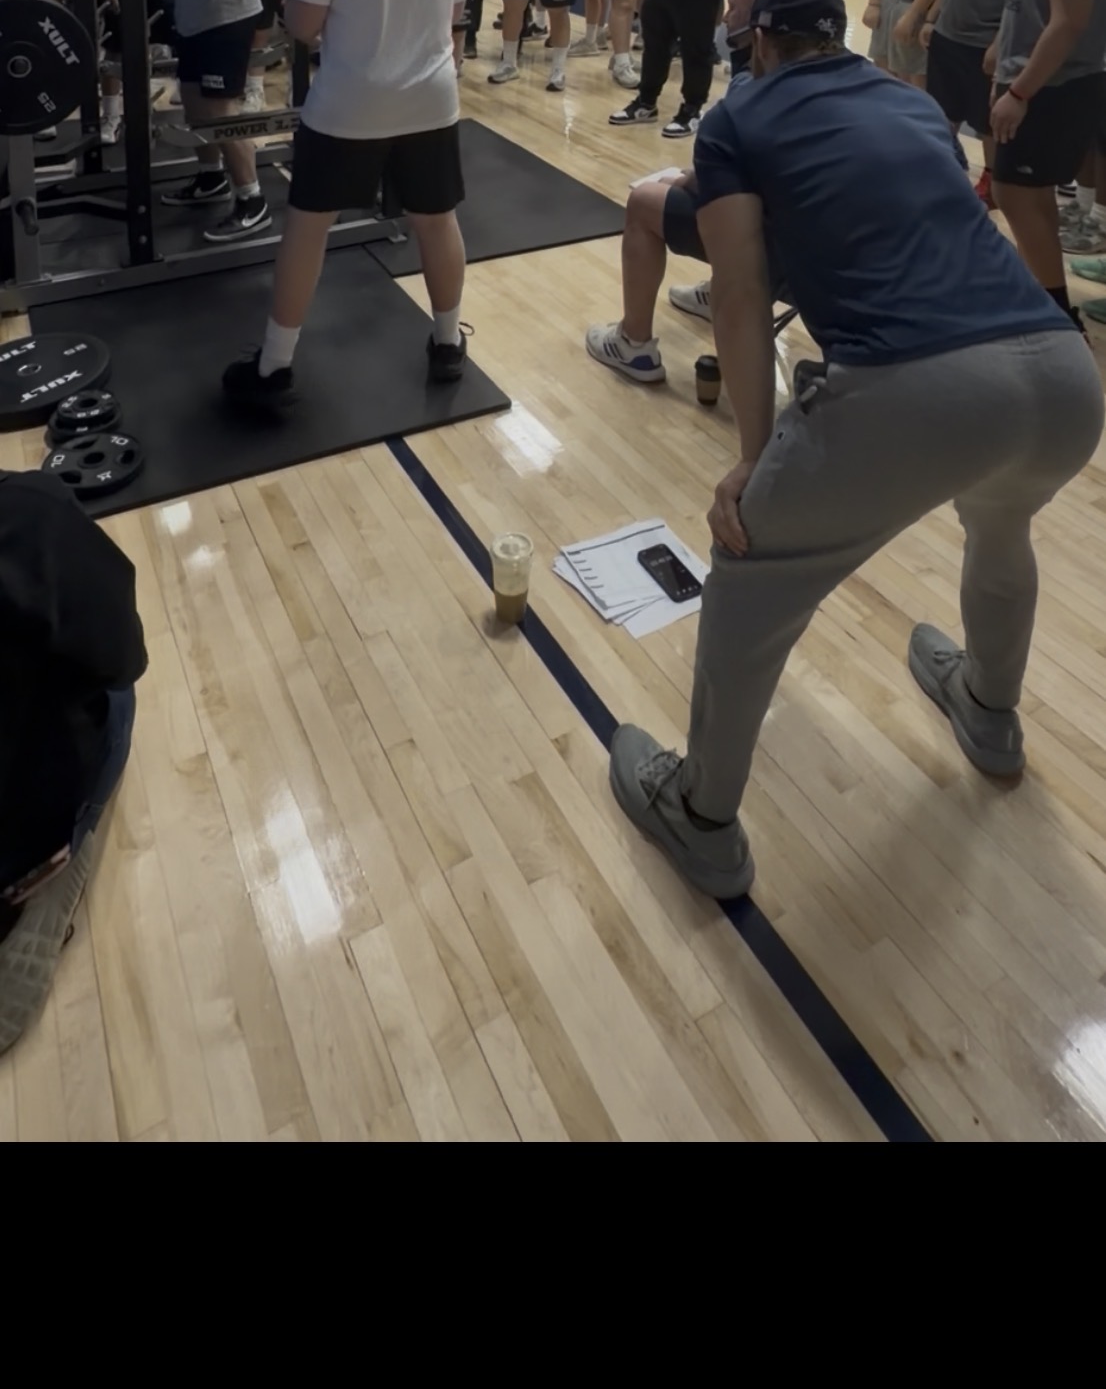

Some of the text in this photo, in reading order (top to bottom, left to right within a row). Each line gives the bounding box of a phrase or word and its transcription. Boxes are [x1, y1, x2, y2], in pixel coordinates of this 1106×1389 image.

[38, 16, 80, 65] XULT
[214, 122, 269, 139] POWER
[20, 370, 83, 403] XULT
